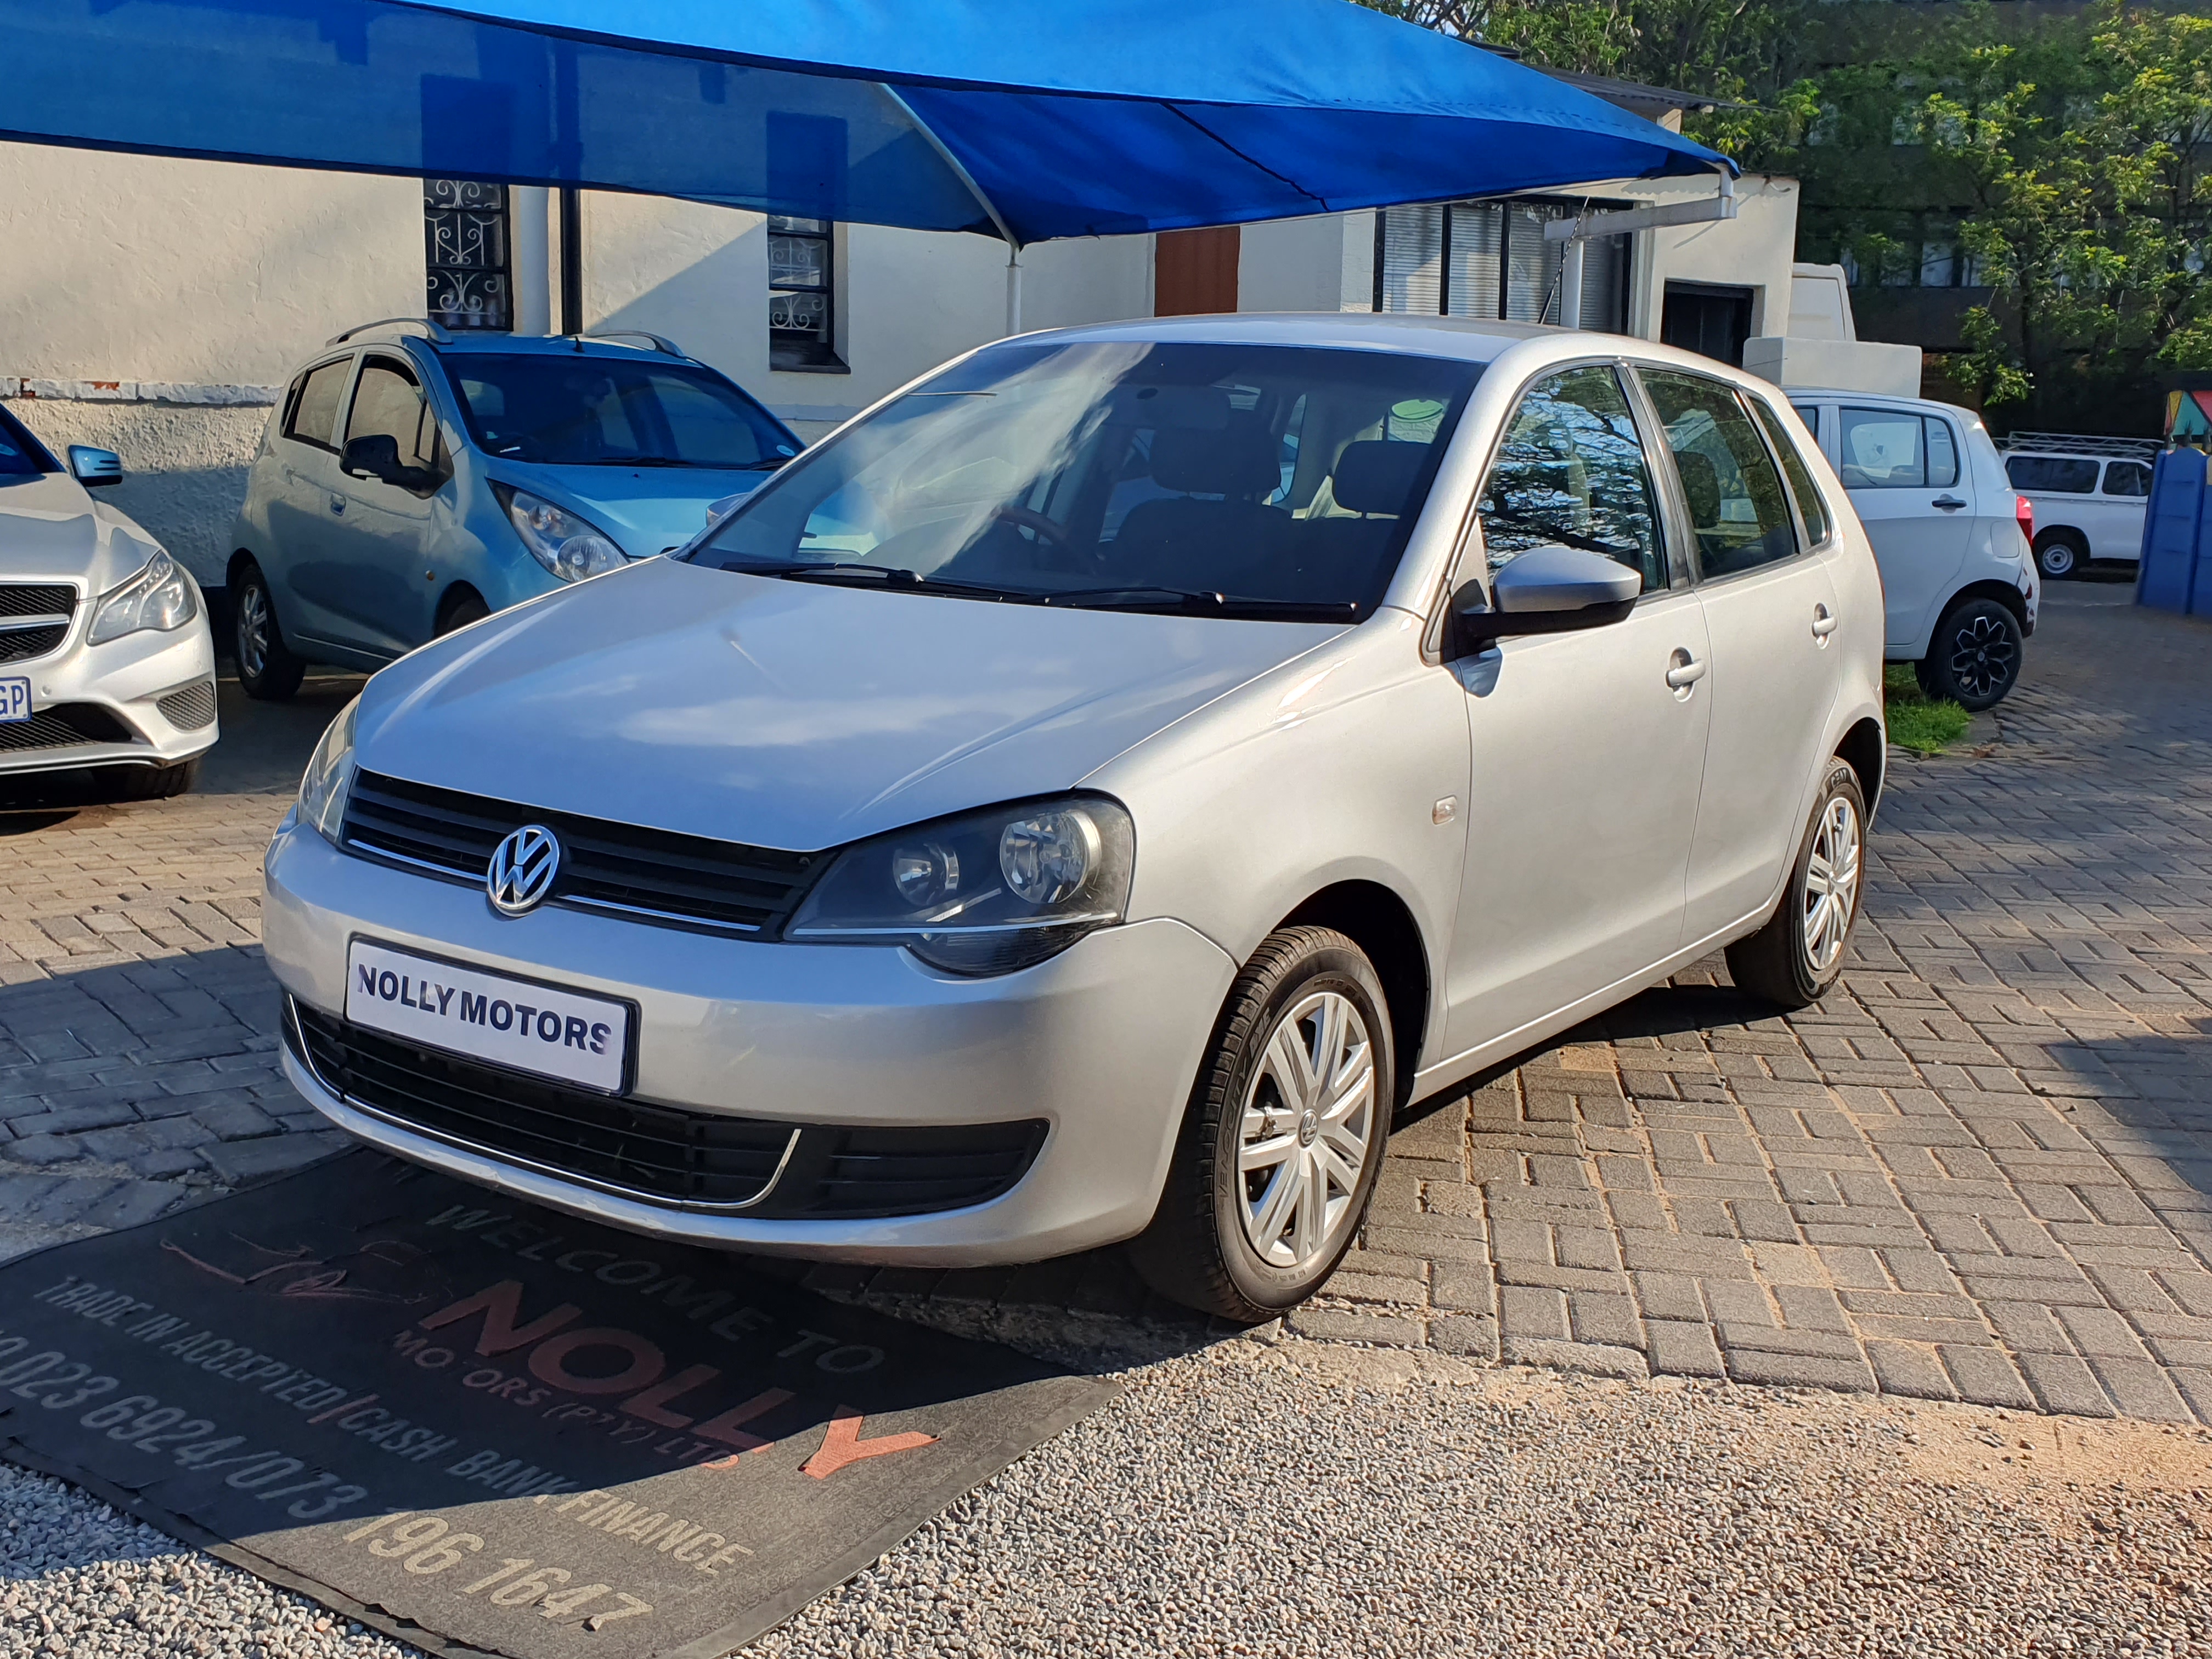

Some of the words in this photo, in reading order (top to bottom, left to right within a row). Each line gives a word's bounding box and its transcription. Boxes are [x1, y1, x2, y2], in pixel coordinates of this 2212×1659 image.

[358, 963, 455, 1017] NOLLY
[460, 991, 612, 1056] MOTORS
[425, 1204, 774, 1342] WELCOME
[776, 1330, 885, 1372] TO
[33, 1274, 154, 1327] TRADE
[124, 1313, 191, 1342] IN
[445, 1449, 580, 1505] BANK
[554, 1489, 755, 1577] FINANCE
[392, 1329, 552, 1406] MOORS
[653, 1436, 740, 1470] LTD
[417, 1278, 941, 1480] NOLLY
[342, 1507, 484, 1574] 196
[461, 1558, 653, 1629] 1647
